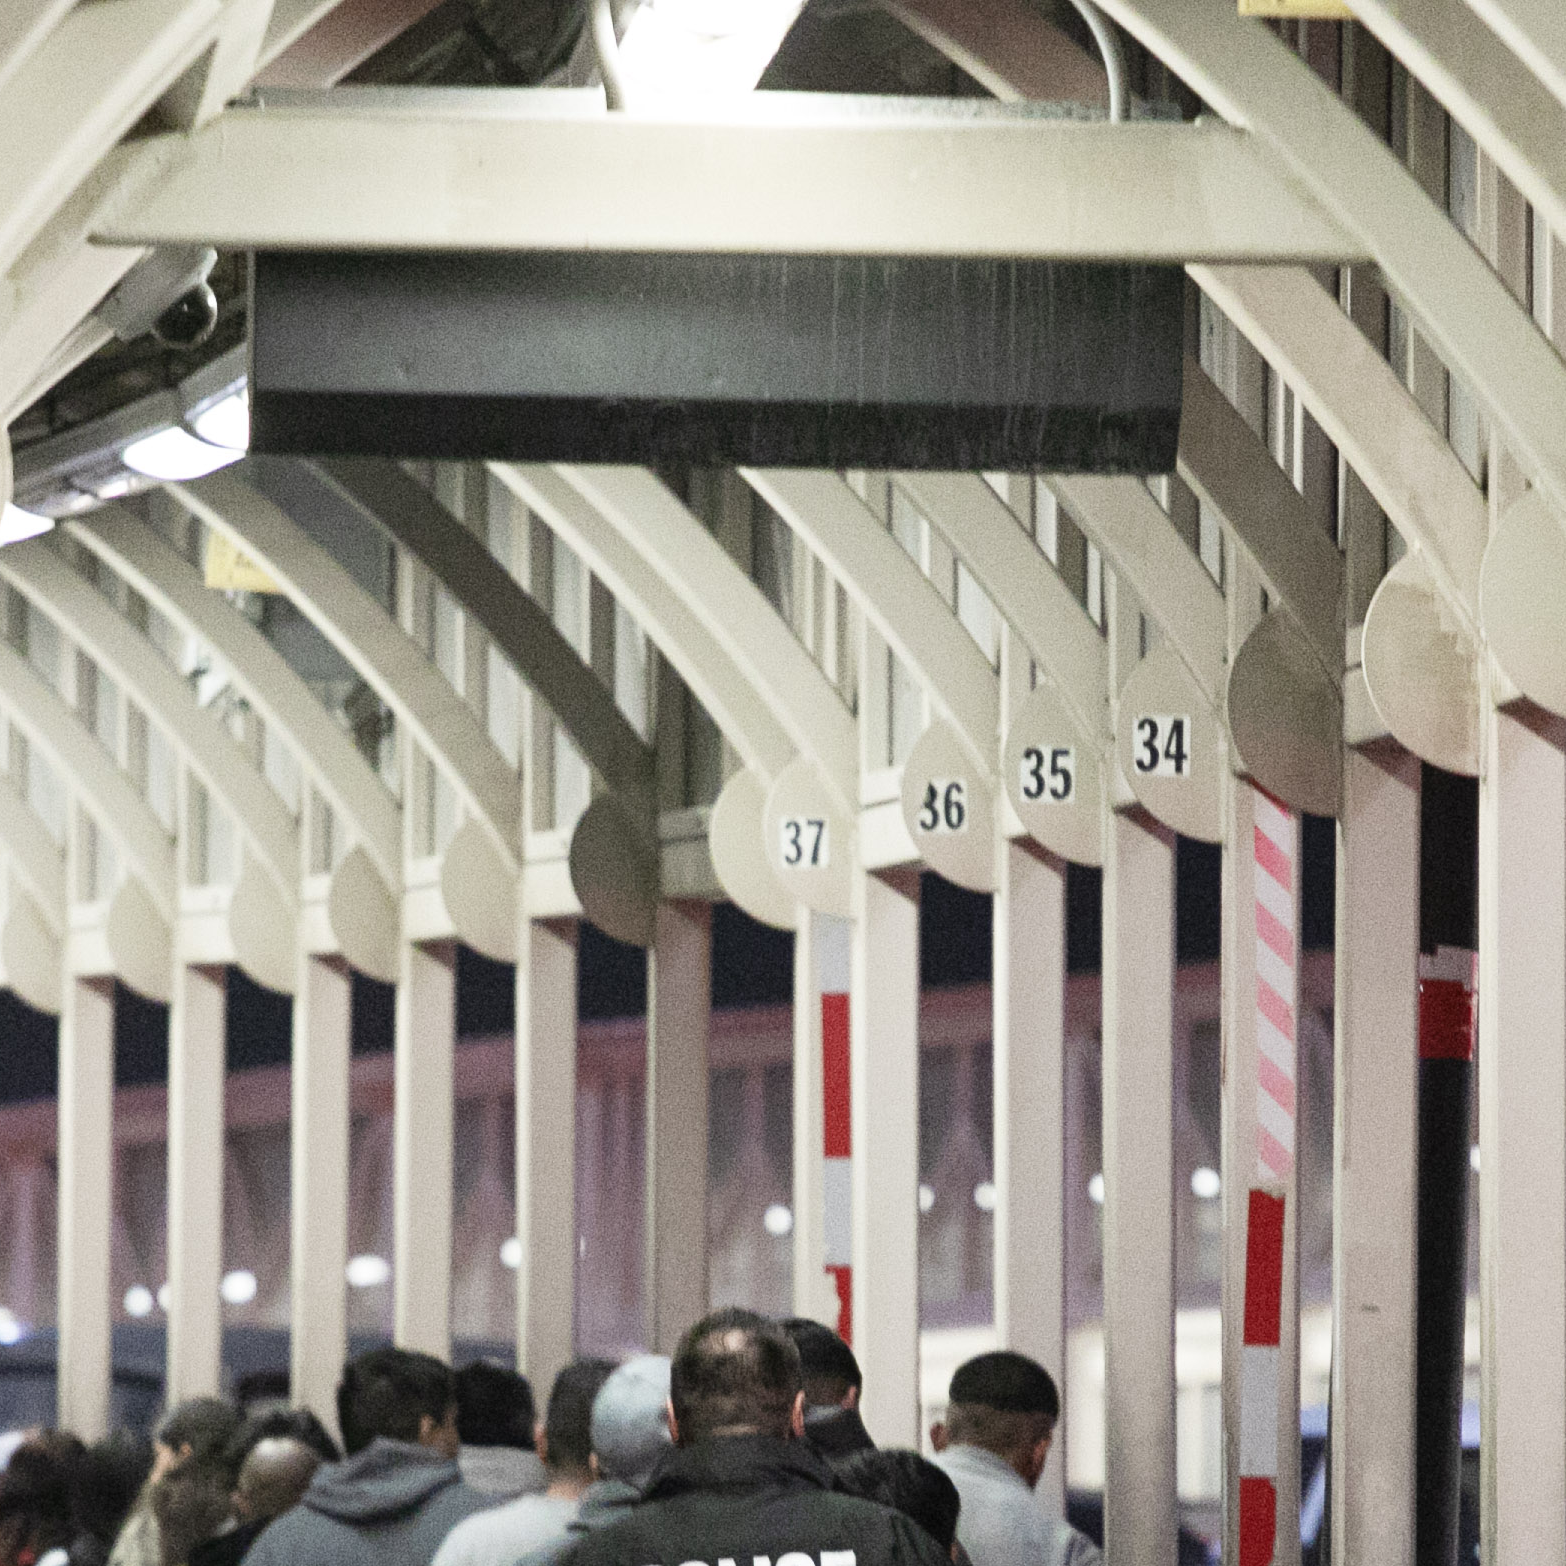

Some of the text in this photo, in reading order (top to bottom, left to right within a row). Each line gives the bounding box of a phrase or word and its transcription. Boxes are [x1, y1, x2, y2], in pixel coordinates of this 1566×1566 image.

[1135, 717, 1188, 775] 34
[1022, 747, 1073, 800] 35
[919, 782, 966, 831] 36
[784, 819, 826, 866] 37
